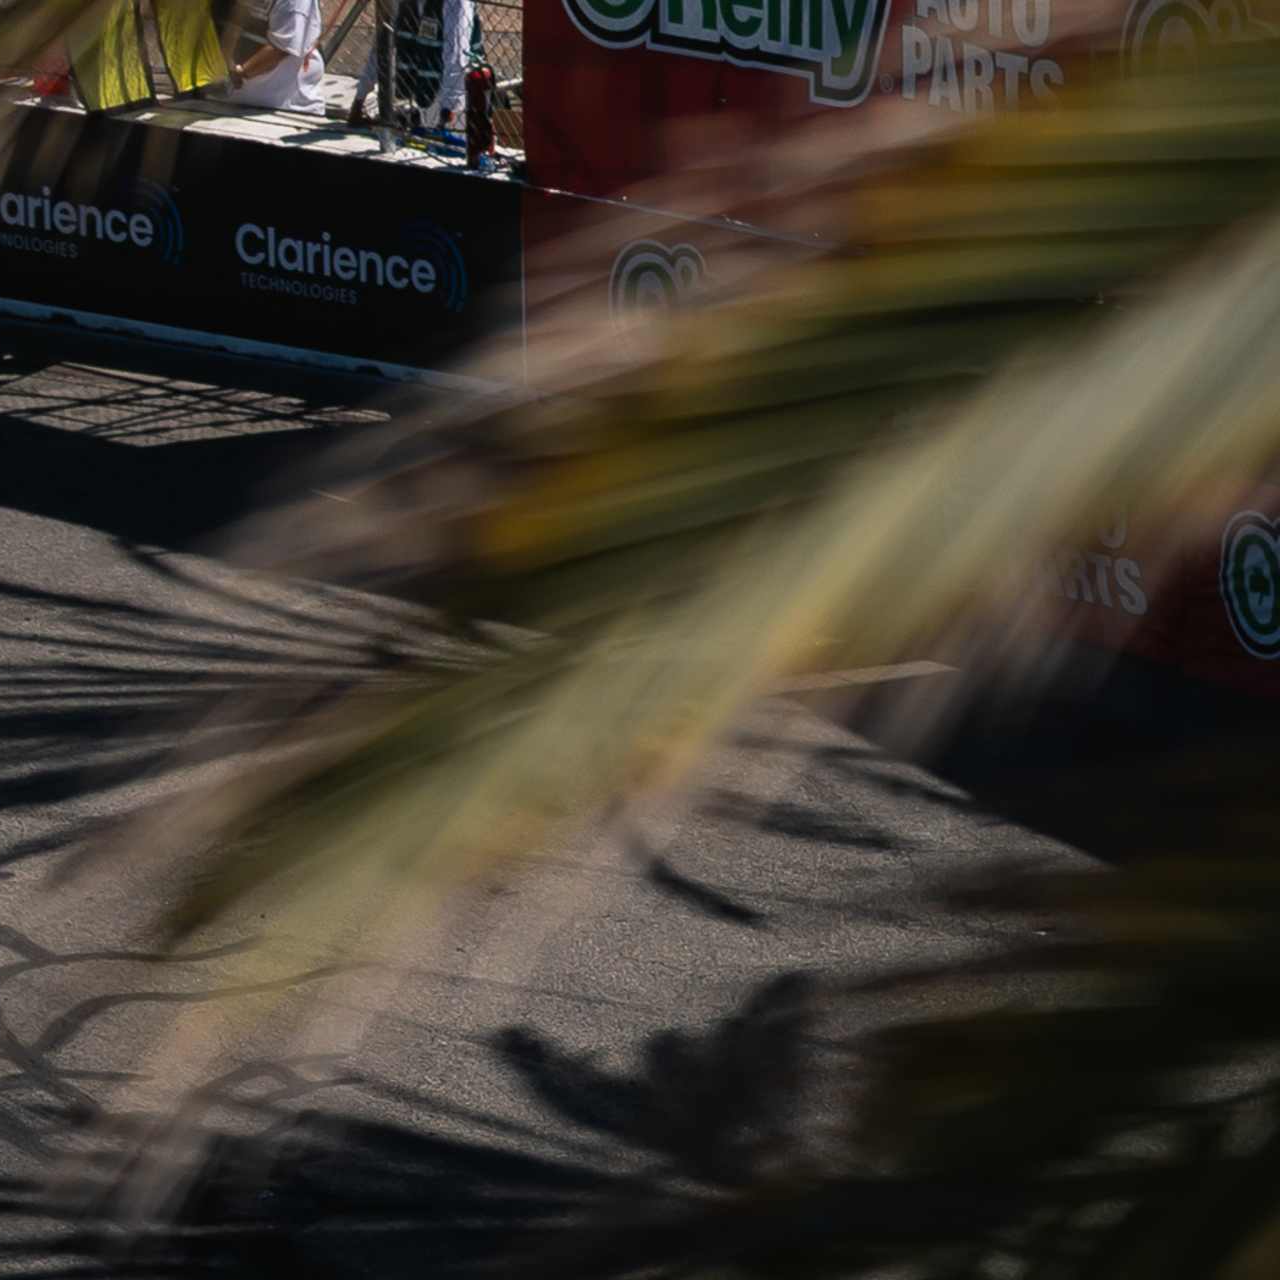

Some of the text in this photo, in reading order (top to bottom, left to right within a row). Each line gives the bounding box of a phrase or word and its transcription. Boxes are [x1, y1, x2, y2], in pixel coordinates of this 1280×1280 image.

[902, 25, 1065, 116] PARTS
[234, 222, 438, 294] Clarience
[240, 272, 360, 305] TECHNOLOGIES
